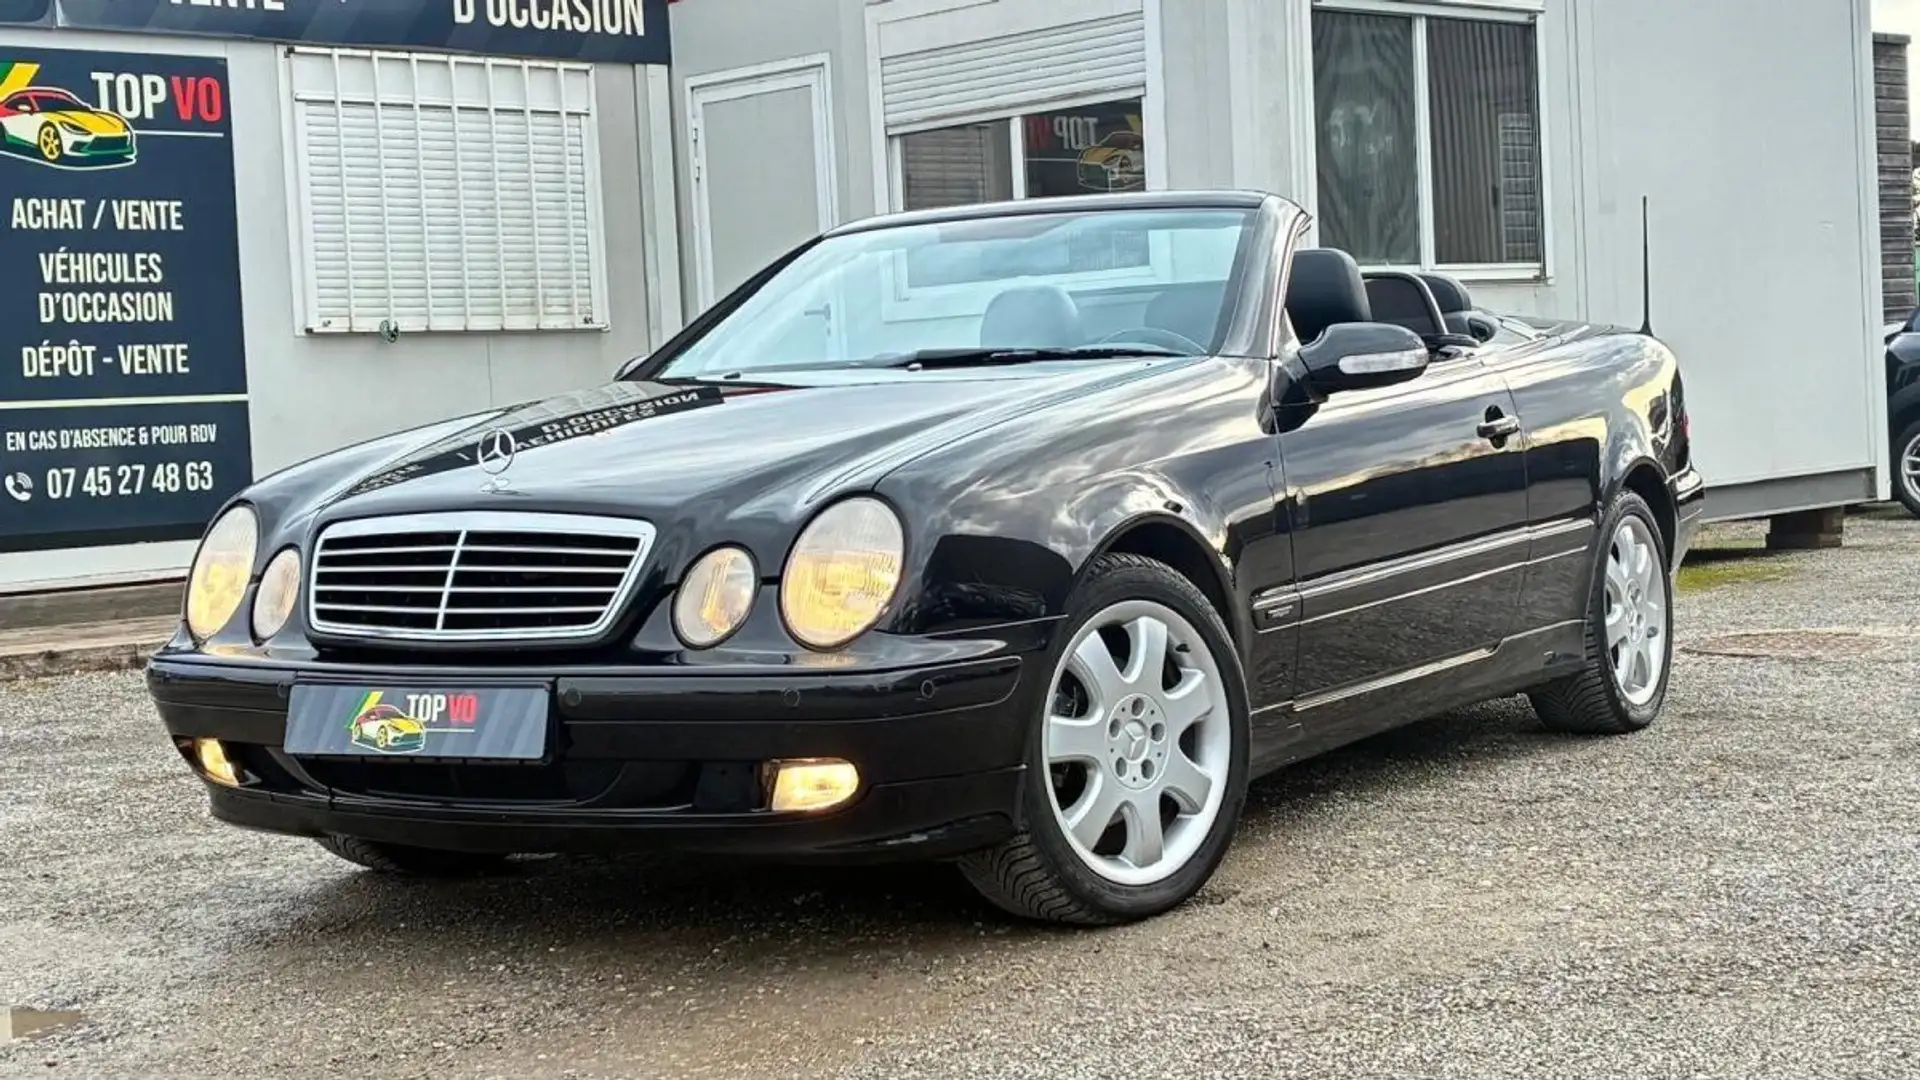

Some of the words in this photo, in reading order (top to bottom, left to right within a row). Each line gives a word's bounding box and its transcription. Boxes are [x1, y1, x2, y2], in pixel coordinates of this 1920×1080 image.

[90, 71, 167, 120] TOP
[171, 76, 223, 122] VO
[11, 198, 86, 230] ACHAT
[92, 200, 106, 230] /
[111, 200, 184, 231] VENTE
[39, 247, 163, 283] VÉHICULES
[38, 292, 173, 323] D'OCCASION
[22, 340, 97, 377] DÉPÔT
[102, 357, 113, 365] -
[118, 344, 190, 375] VENTE
[6, 432, 26, 451] EN
[29, 430, 57, 450] CAS
[60, 428, 136, 449] D'ABSENCE
[139, 427, 149, 445] &
[152, 425, 187, 444] POUR
[190, 424, 217, 443] RDV
[46, 468, 76, 499] 07
[82, 466, 112, 496] 45
[118, 465, 145, 494] 27
[152, 463, 180, 492] 48
[185, 461, 213, 490] 63
[406, 694, 446, 722] TOP
[449, 695, 477, 723] VO
